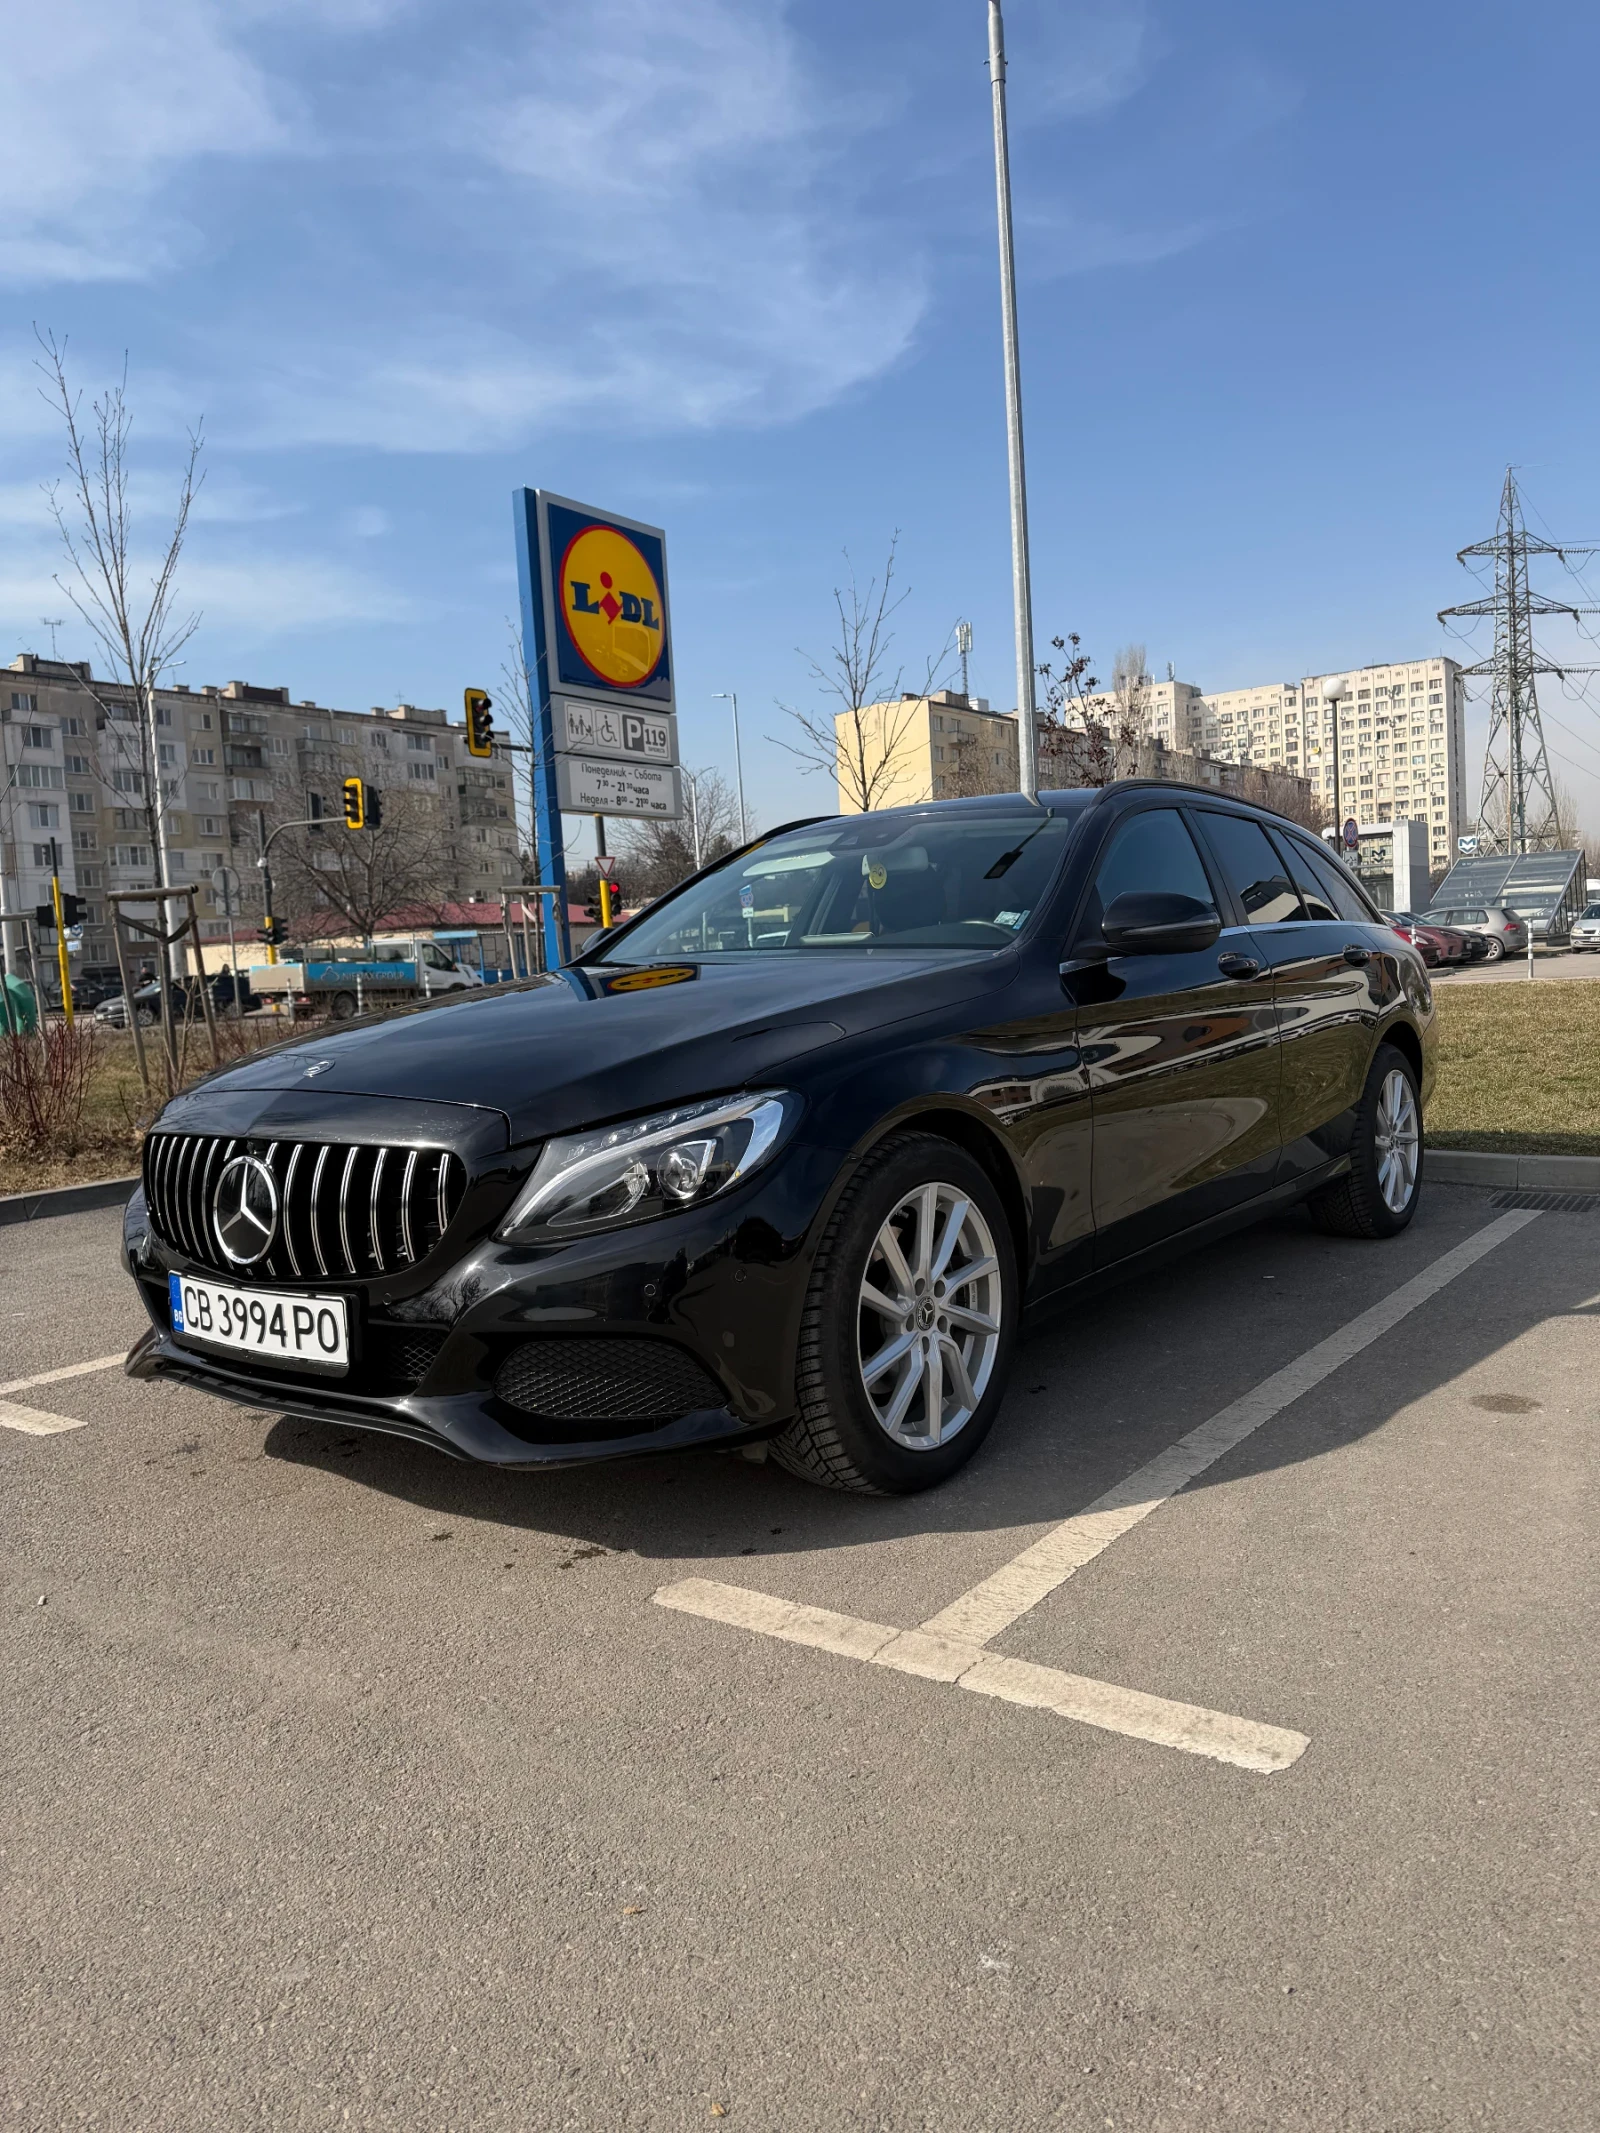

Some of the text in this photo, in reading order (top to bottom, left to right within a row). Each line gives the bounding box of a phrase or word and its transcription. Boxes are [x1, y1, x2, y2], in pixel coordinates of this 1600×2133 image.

[626, 718, 666, 748] P 119
[581, 763, 627, 778] Понеделник
[634, 769, 662, 782] Събота
[633, 786, 650, 795] часа
[580, 793, 608, 807] Неделя
[650, 801, 667, 811] часа
[375, 971, 404, 980] GROUP
[173, 1308, 183, 1323] BG
